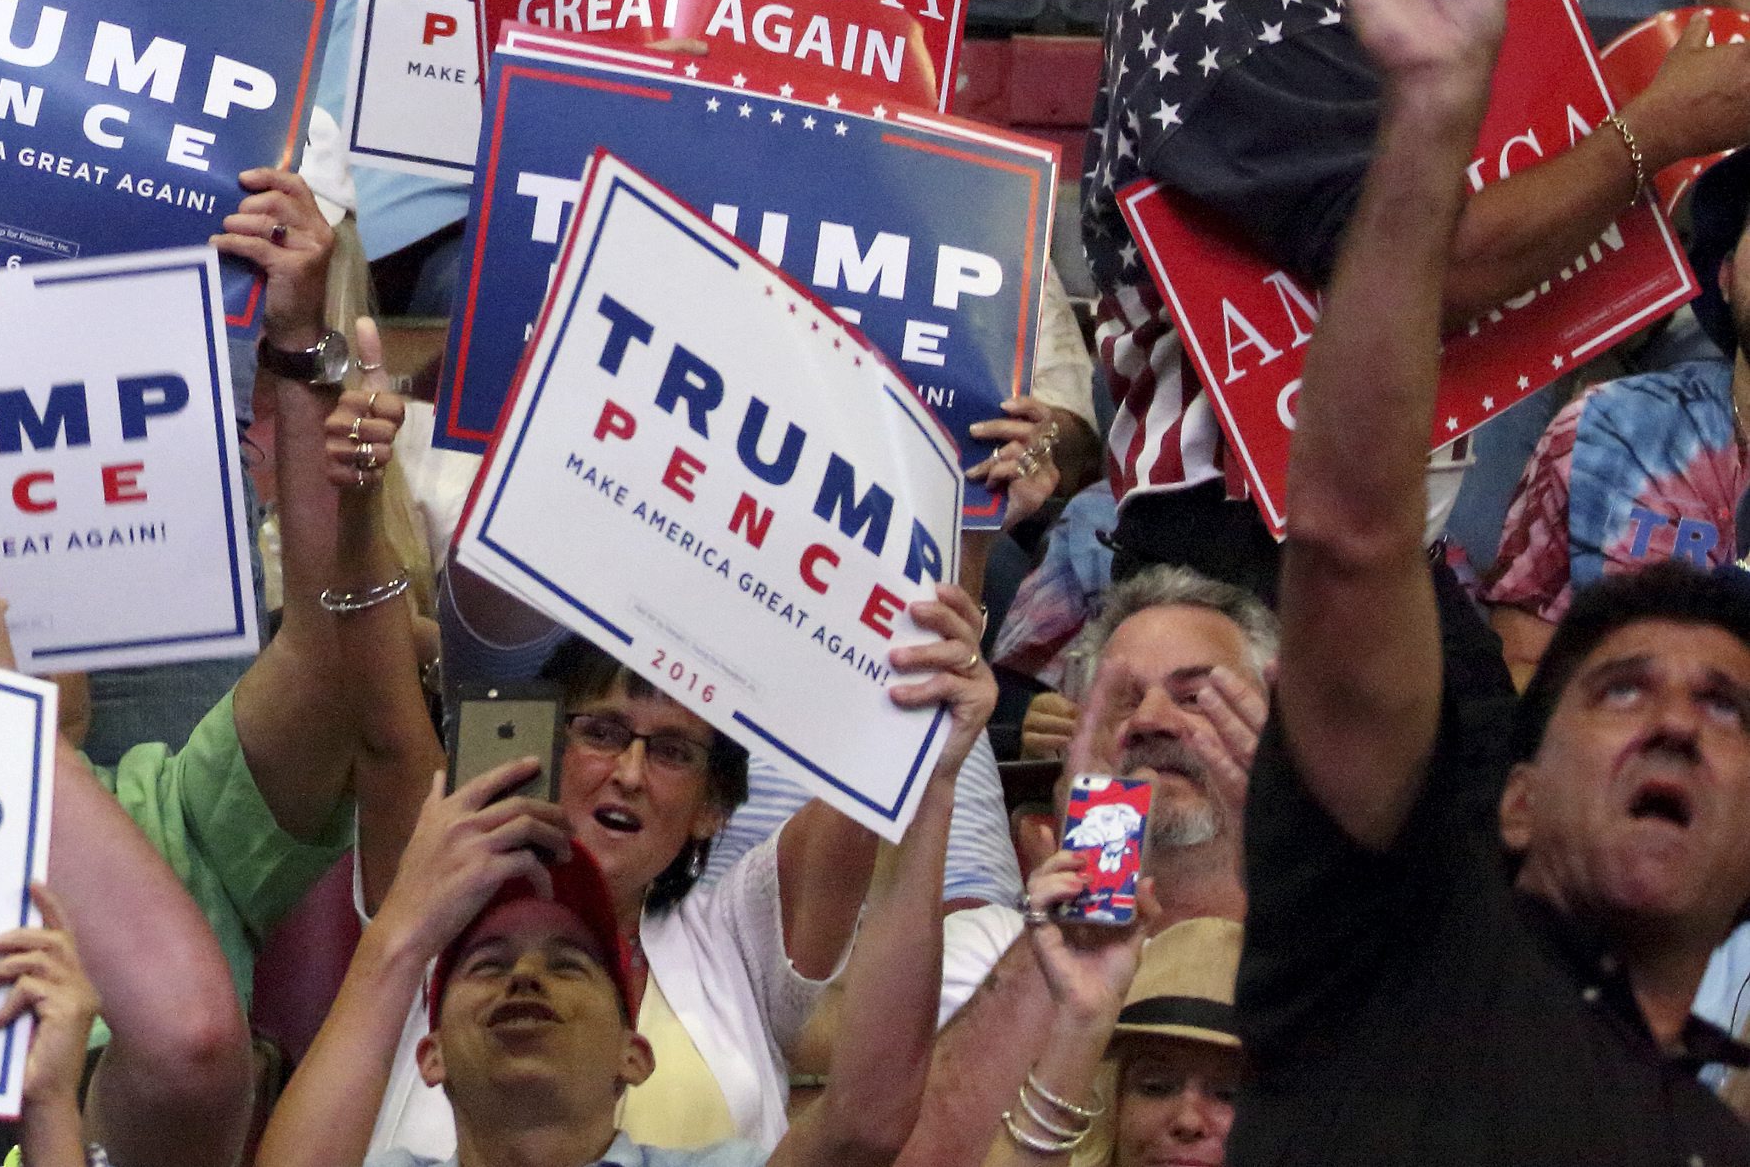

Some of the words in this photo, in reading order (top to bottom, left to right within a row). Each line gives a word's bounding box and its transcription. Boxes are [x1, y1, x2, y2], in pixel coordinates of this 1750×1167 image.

[407, 60, 466, 84] MAKE
[18, 147, 109, 186] GREAT
[116, 173, 216, 214] AGAIN!
[7, 228, 19, 238] for
[516, 171, 1002, 310] TUMP
[596, 293, 942, 586] TRUMP
[66, 523, 168, 552] AGAIN!
[593, 398, 907, 640] PENCE
[566, 452, 628, 506] MAKE
[633, 501, 730, 579] AMERICA
[739, 573, 810, 631] GREAT
[811, 625, 891, 687] AGAIN!
[650, 648, 716, 703] 2016
